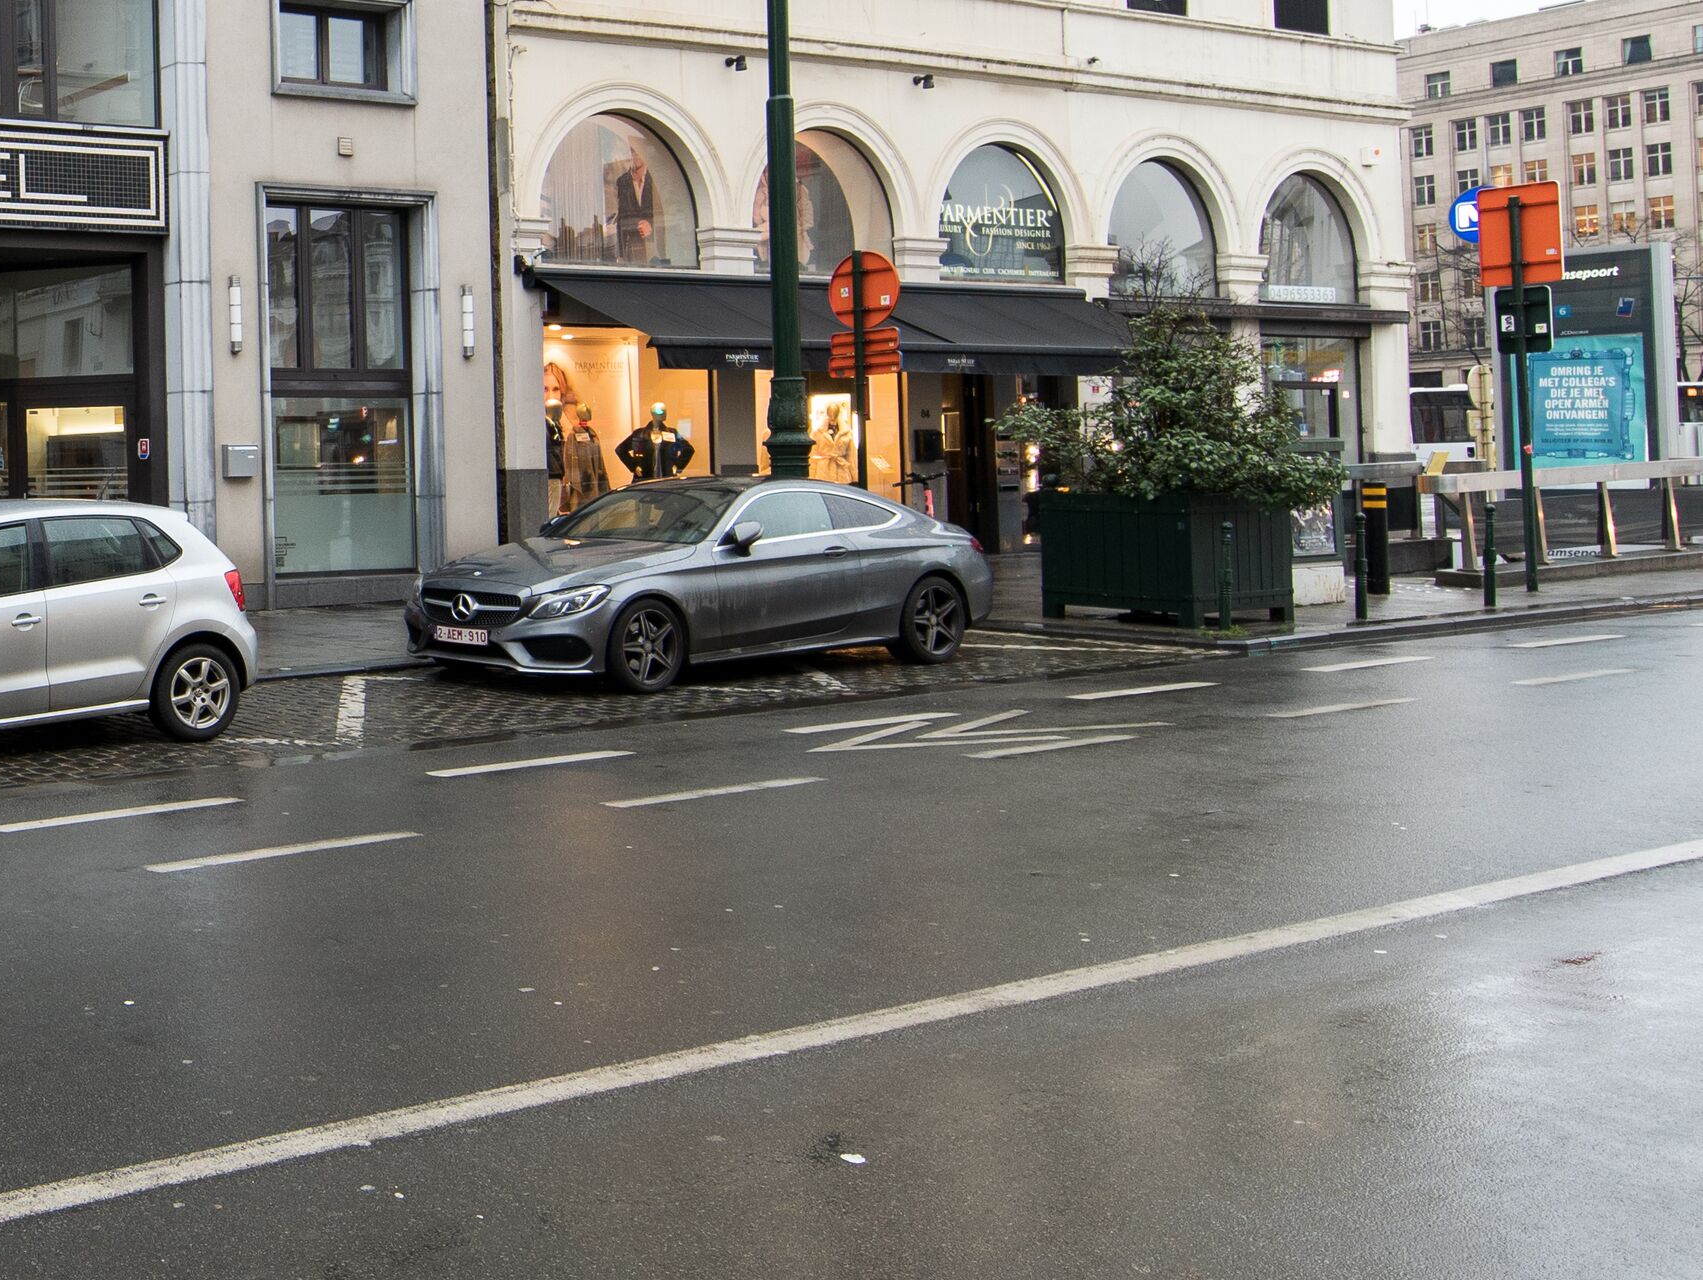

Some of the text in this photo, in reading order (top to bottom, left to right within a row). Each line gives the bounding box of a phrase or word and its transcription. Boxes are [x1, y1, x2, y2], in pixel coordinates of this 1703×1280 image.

[939, 224, 1052, 238] UXURY FASHION DESIGNER
[1015, 241, 1035, 251] SINCE
[1562, 265, 1620, 280] msepoort
[1559, 307, 1567, 316] 6
[1550, 365, 1604, 376] OMRING JE
[1539, 376, 1616, 388] MET COLLEGA'S
[1550, 387, 1604, 398] DIE JE MET
[1544, 399, 1609, 409] OPEN ARMEN
[1546, 409, 1608, 420] ONTVANGEN!
[438, 627, 487, 643] 2-AEM-910
